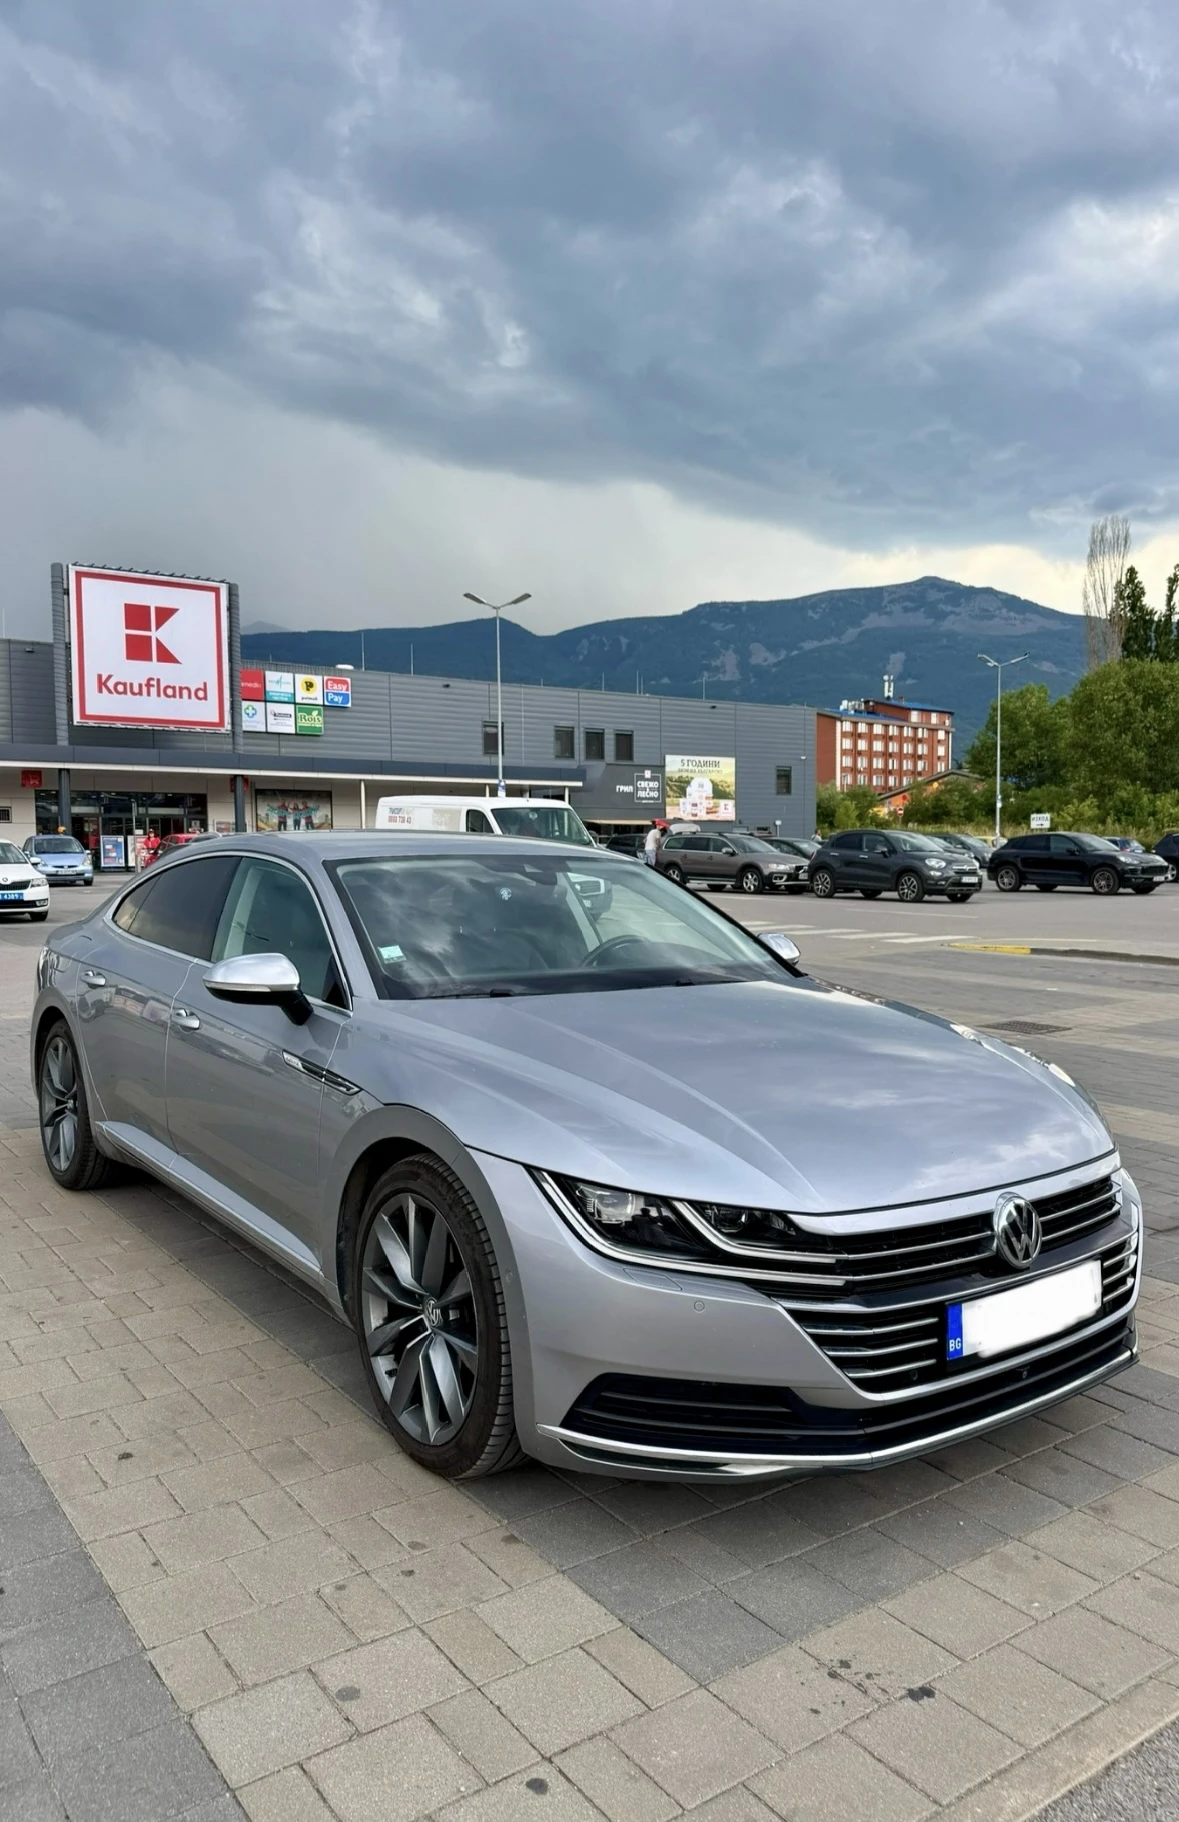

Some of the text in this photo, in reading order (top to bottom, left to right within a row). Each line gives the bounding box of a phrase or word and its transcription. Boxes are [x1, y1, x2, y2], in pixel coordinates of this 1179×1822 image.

[96, 673, 208, 701] Kaufland
[327, 682, 348, 691] Easy
[328, 693, 344, 704] Pay
[299, 713, 321, 723] Rois
[681, 759, 720, 768] 5 ГОДИНИ
[949, 1338, 962, 1352] BG
